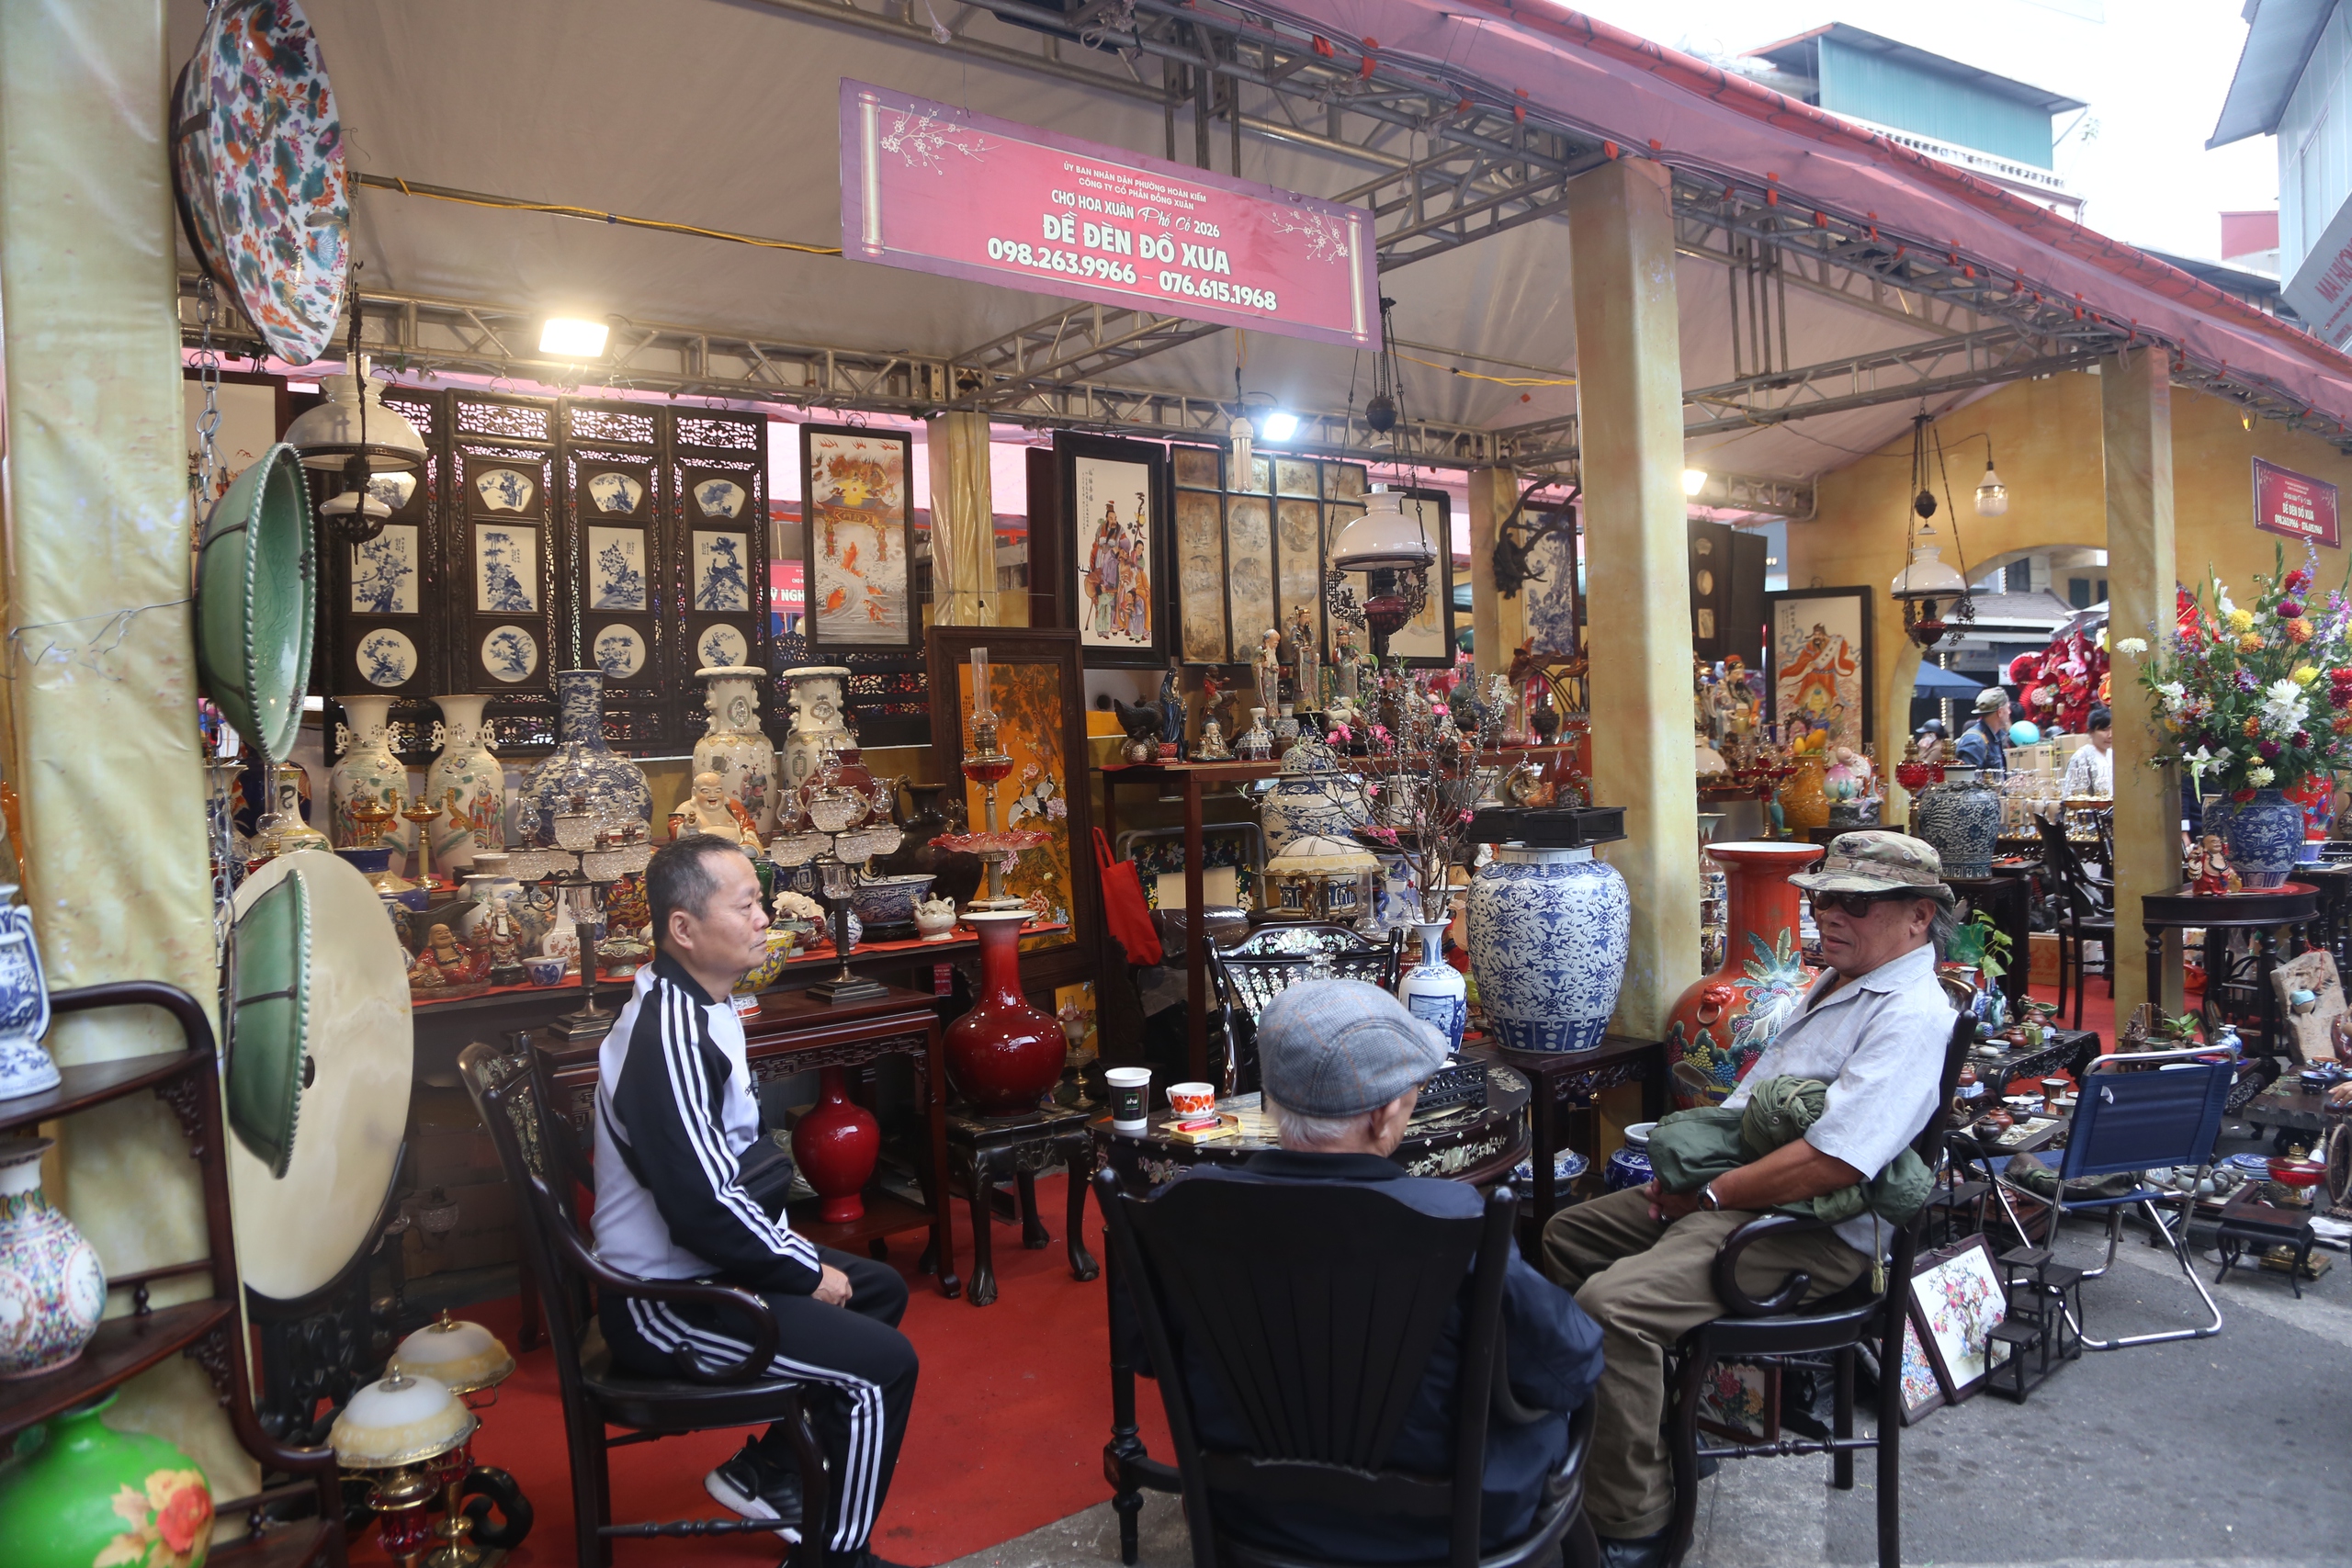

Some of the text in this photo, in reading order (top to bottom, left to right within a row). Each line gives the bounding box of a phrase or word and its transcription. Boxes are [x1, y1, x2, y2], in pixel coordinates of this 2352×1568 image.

[1063, 161, 1074, 172] ỦY
[1076, 165, 1092, 176] BAN
[1093, 169, 1115, 181] NHÂN
[1116, 174, 1134, 186] DÂN
[1135, 178, 1166, 193] PHƯỜNG
[1167, 186, 1189, 198] HOÀN
[1078, 177, 1194, 210] CÔNG TY CỔ PHẦN ĐỒNG XUÂN
[1051, 189, 1220, 238] CHỢ HOA XUÂN Phố Cổ 2026
[1043, 210, 1231, 276] ĐỀ ĐÈN ĐỒ XƯA
[987, 237, 1137, 285] 098.263.9966
[1159, 270, 1278, 311] 076.615.1968
[2314, 272, 2344, 304] MAI
